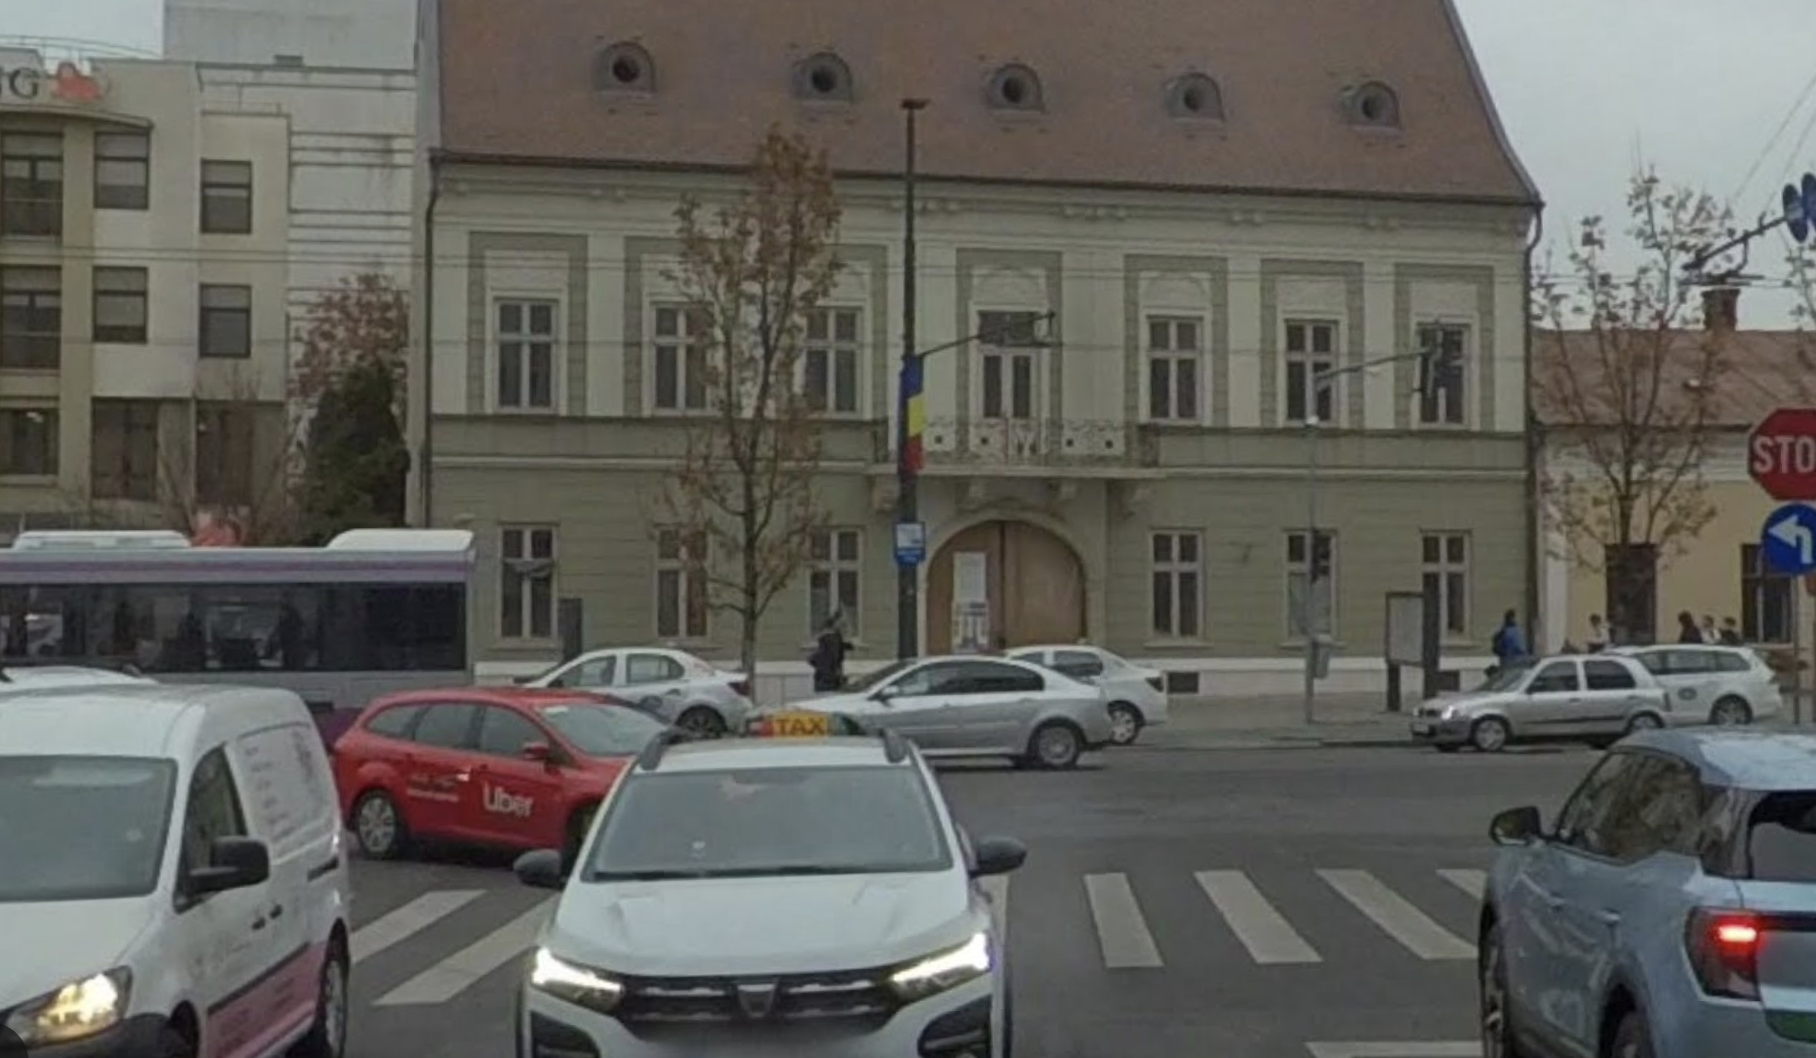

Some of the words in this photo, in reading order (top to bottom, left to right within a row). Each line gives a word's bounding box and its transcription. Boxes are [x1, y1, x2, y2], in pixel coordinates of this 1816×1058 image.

[0, 66, 39, 99] G
[1752, 434, 1816, 474] STO
[481, 780, 534, 818] Uber
